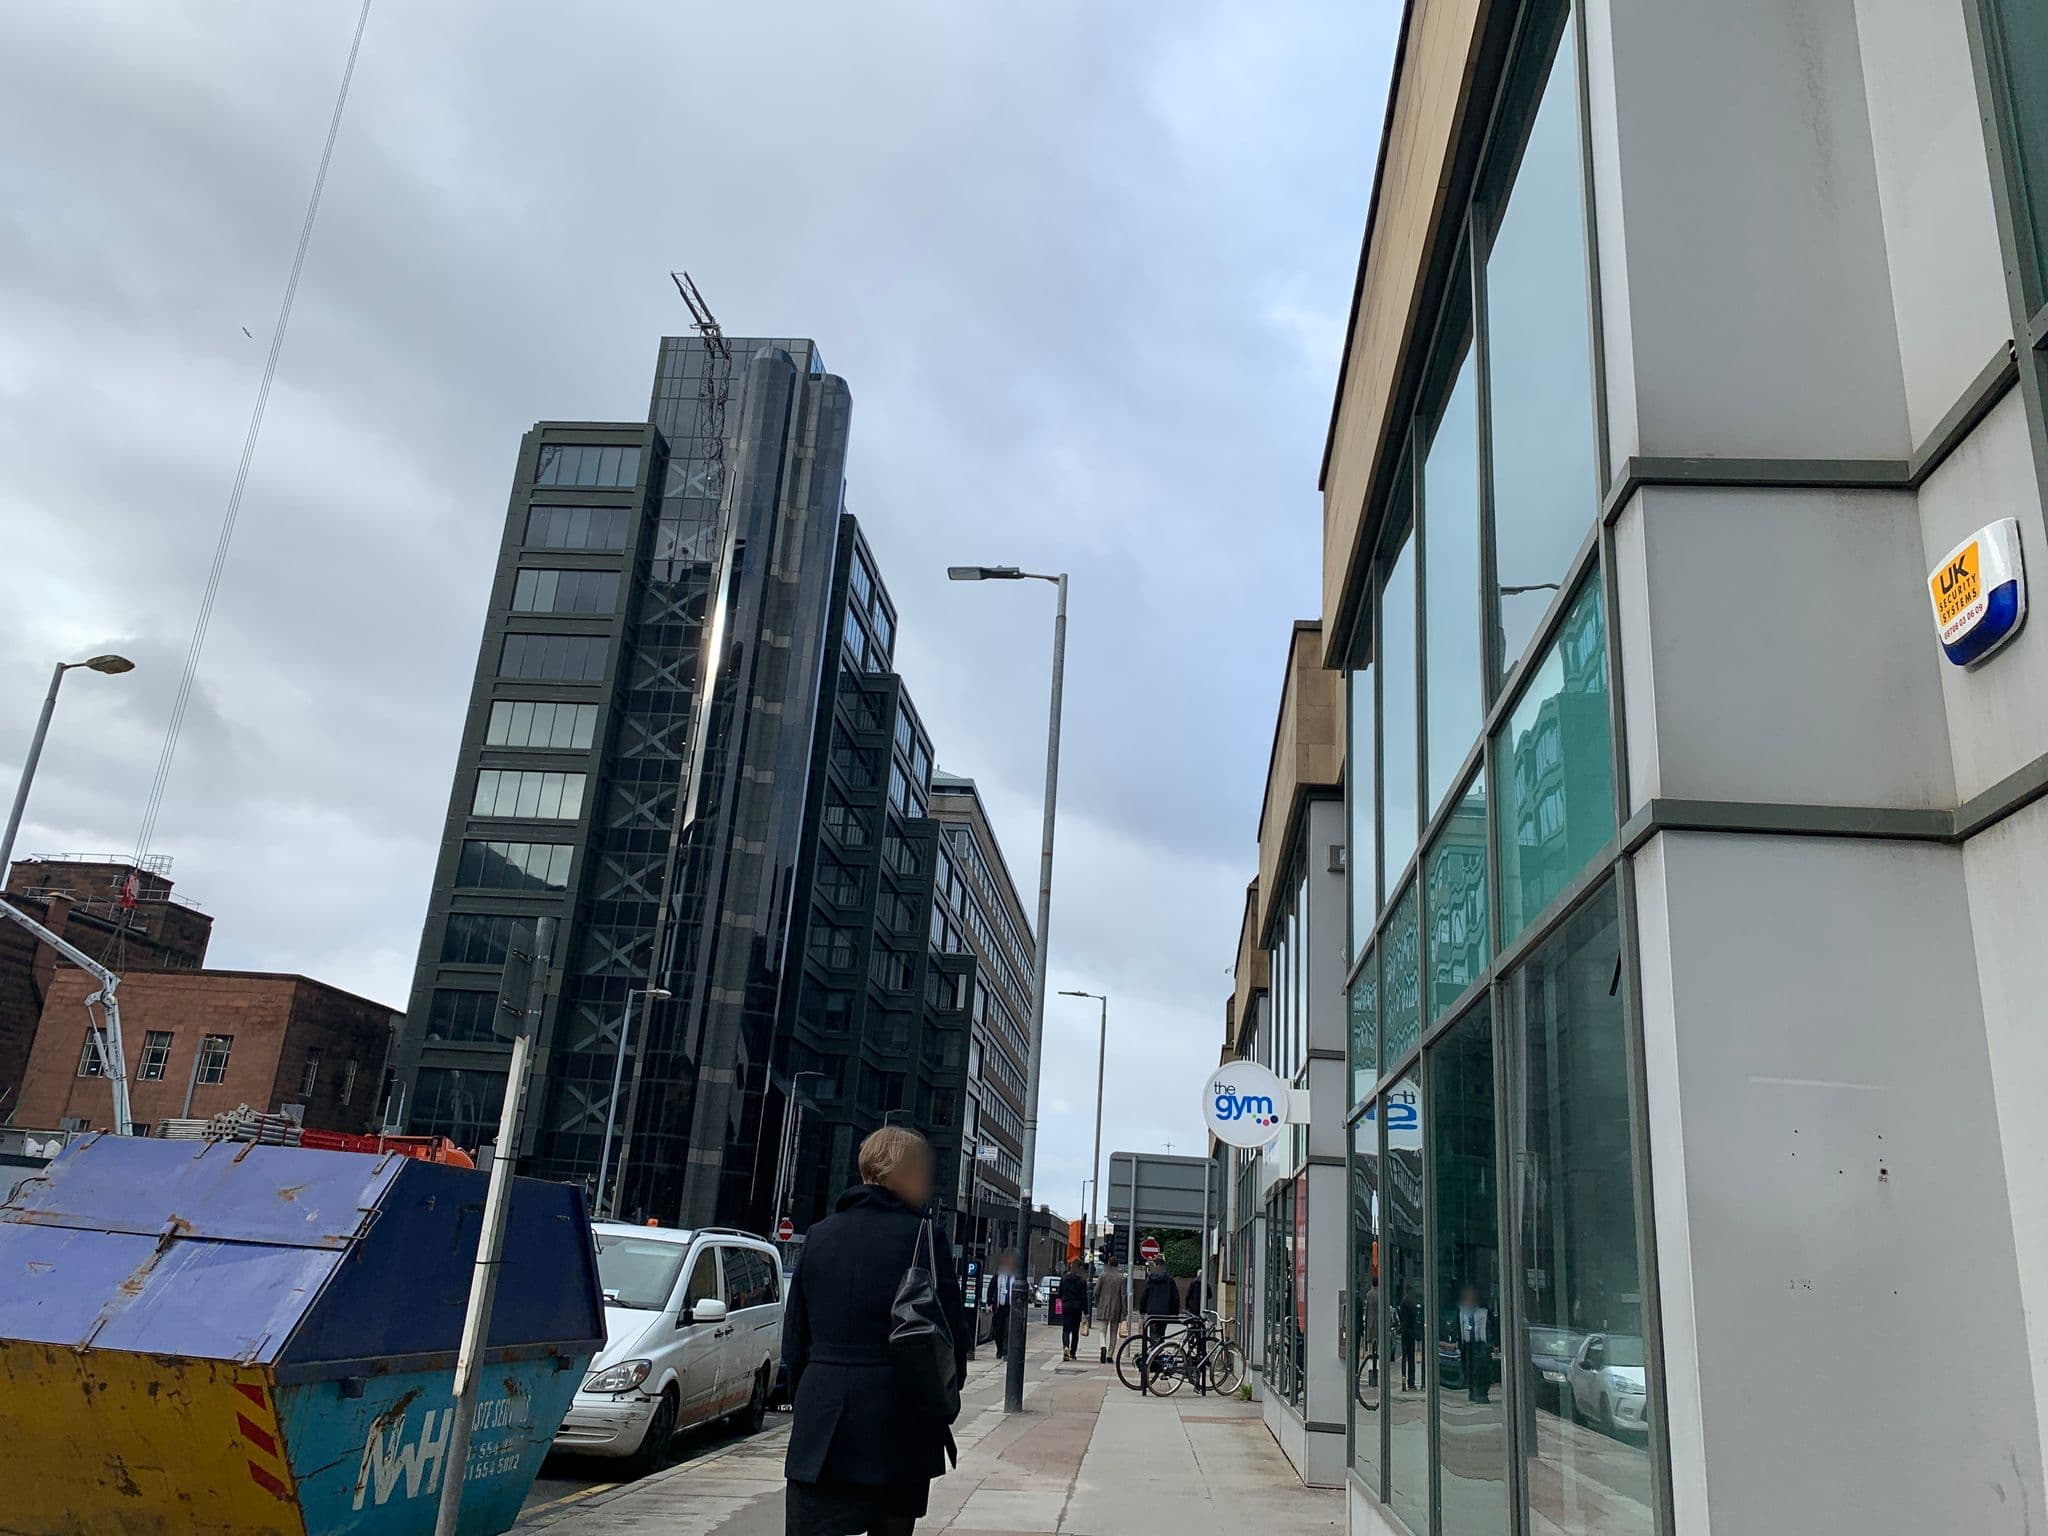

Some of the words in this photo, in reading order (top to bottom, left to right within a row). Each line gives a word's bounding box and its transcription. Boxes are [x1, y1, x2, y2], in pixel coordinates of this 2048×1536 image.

[1939, 573, 1976, 612] SECURITY
[1940, 554, 1969, 595] UK
[1942, 587, 1977, 623] SYSTEMS
[1214, 1081, 1236, 1095] the
[1215, 1095, 1273, 1121] gym
